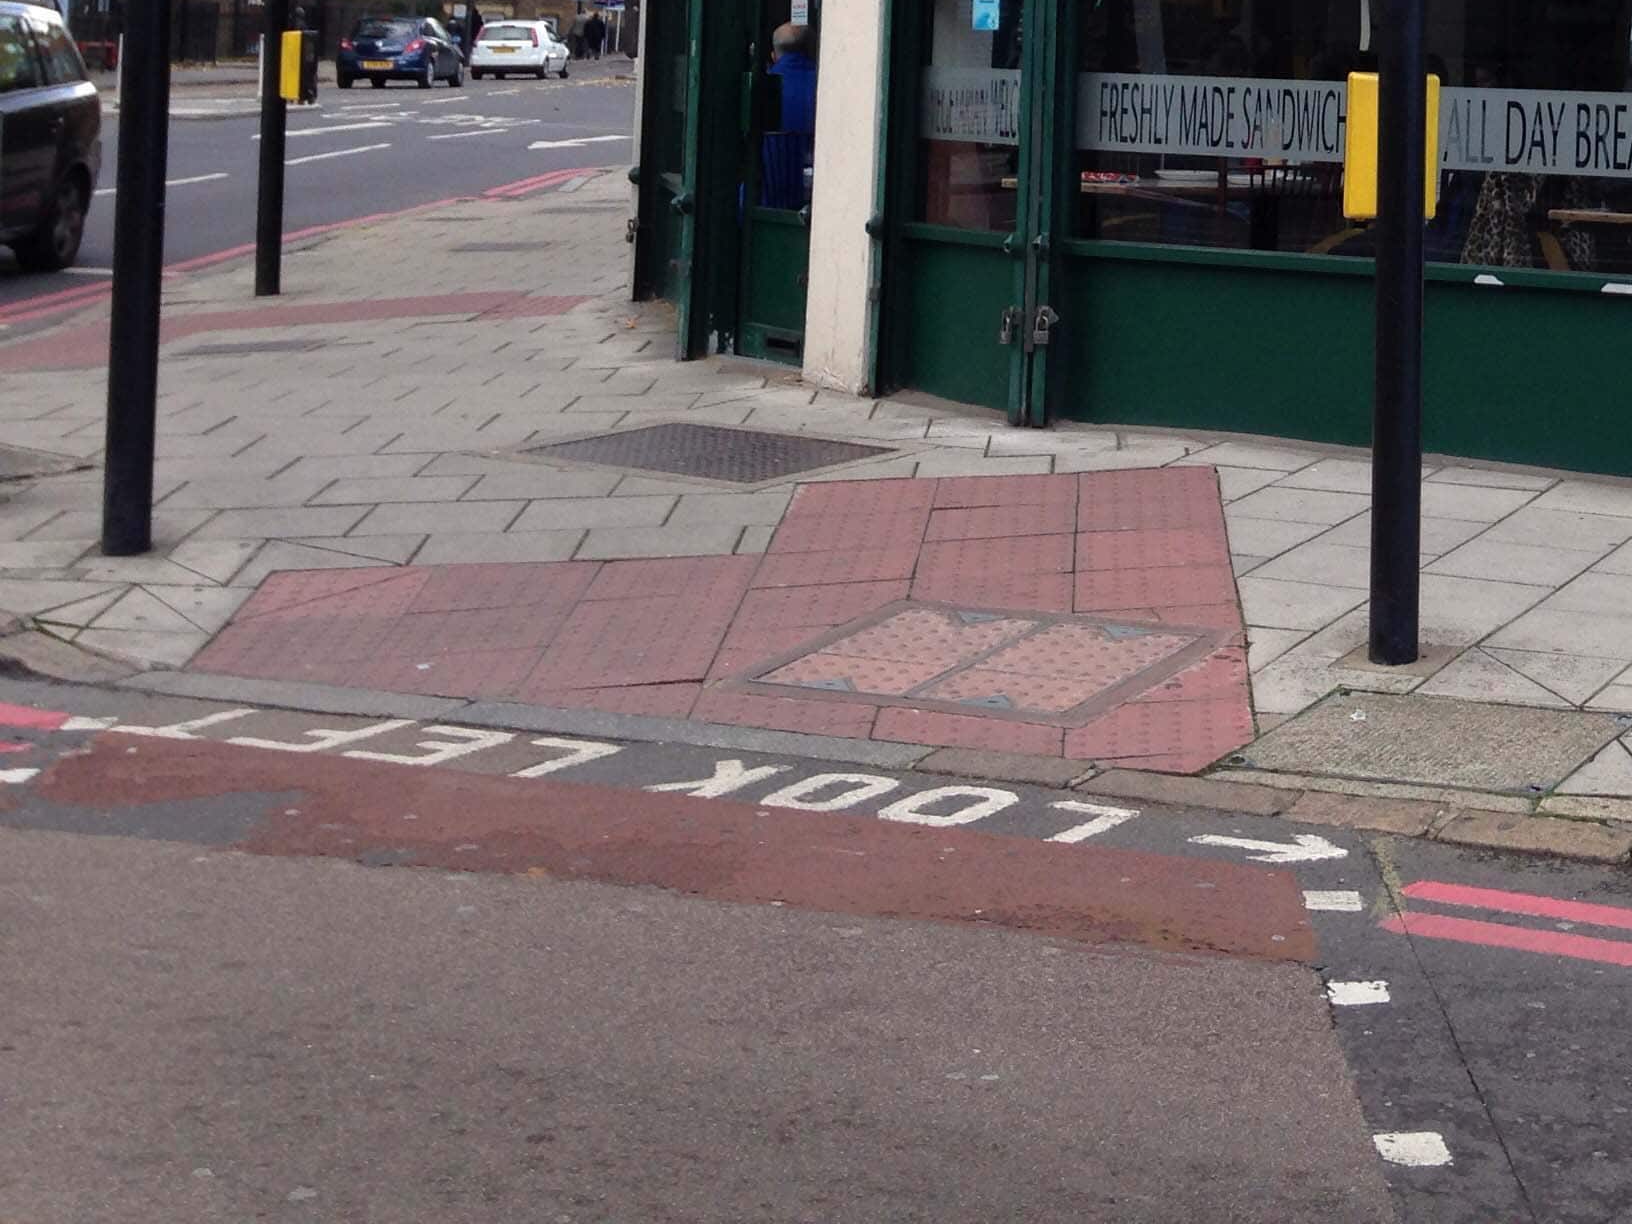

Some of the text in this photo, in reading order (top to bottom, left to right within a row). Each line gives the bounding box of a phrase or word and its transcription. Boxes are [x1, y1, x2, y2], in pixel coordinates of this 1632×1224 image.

[1098, 83, 1174, 144] FRESHLY
[1178, 86, 1235, 148] MADE
[1443, 98, 1494, 163] ALL
[1505, 100, 1565, 166] DAY
[110, 708, 1141, 843] LOOK LEFT
